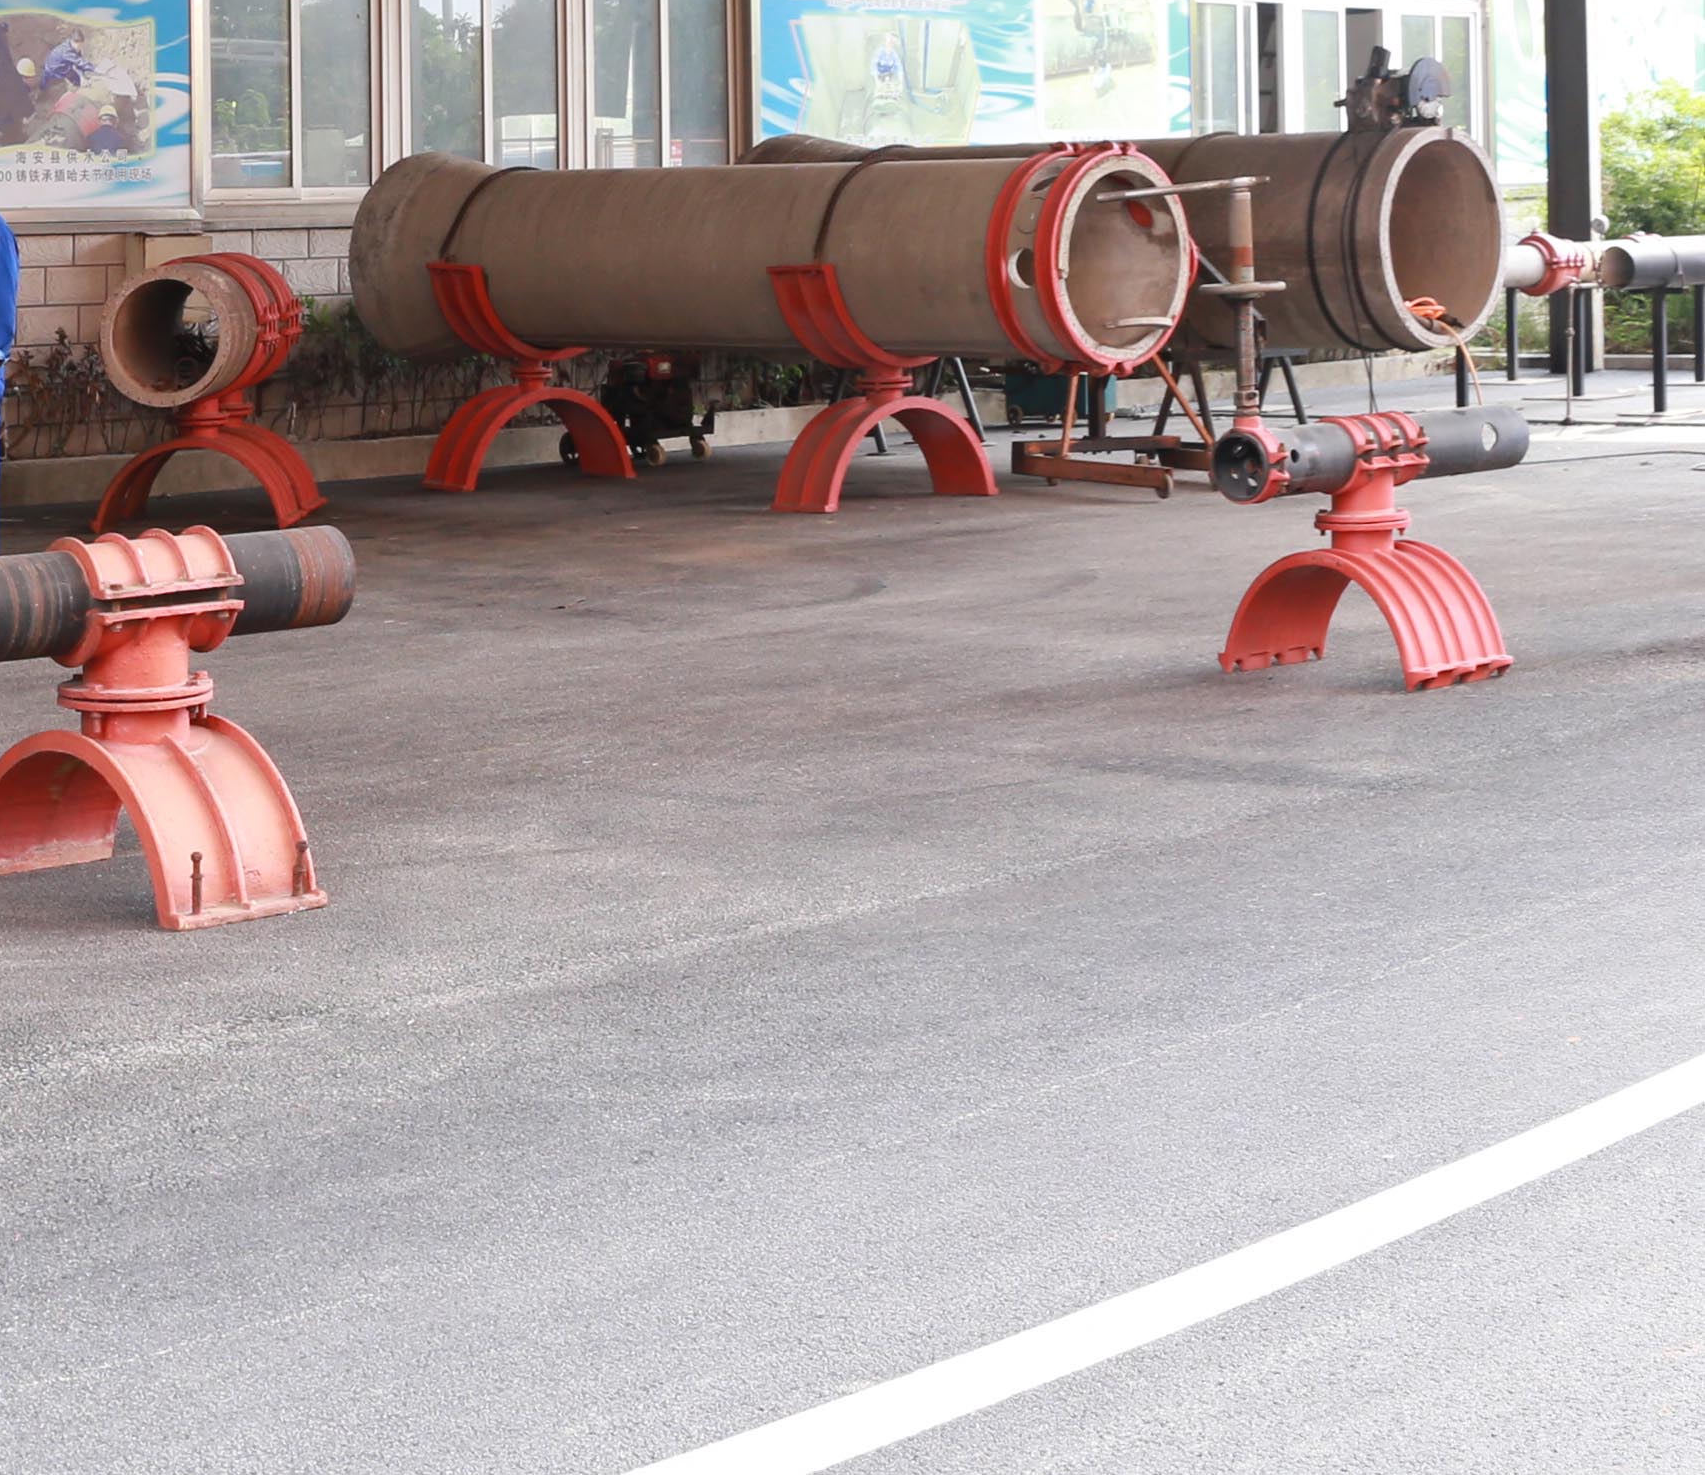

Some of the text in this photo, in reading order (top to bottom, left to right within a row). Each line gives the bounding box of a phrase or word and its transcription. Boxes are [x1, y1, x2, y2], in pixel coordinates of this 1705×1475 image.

[15, 148, 129, 165] 海安县供水公司
[15, 168, 153, 184] 铸铁承插哈夫节使用现场
